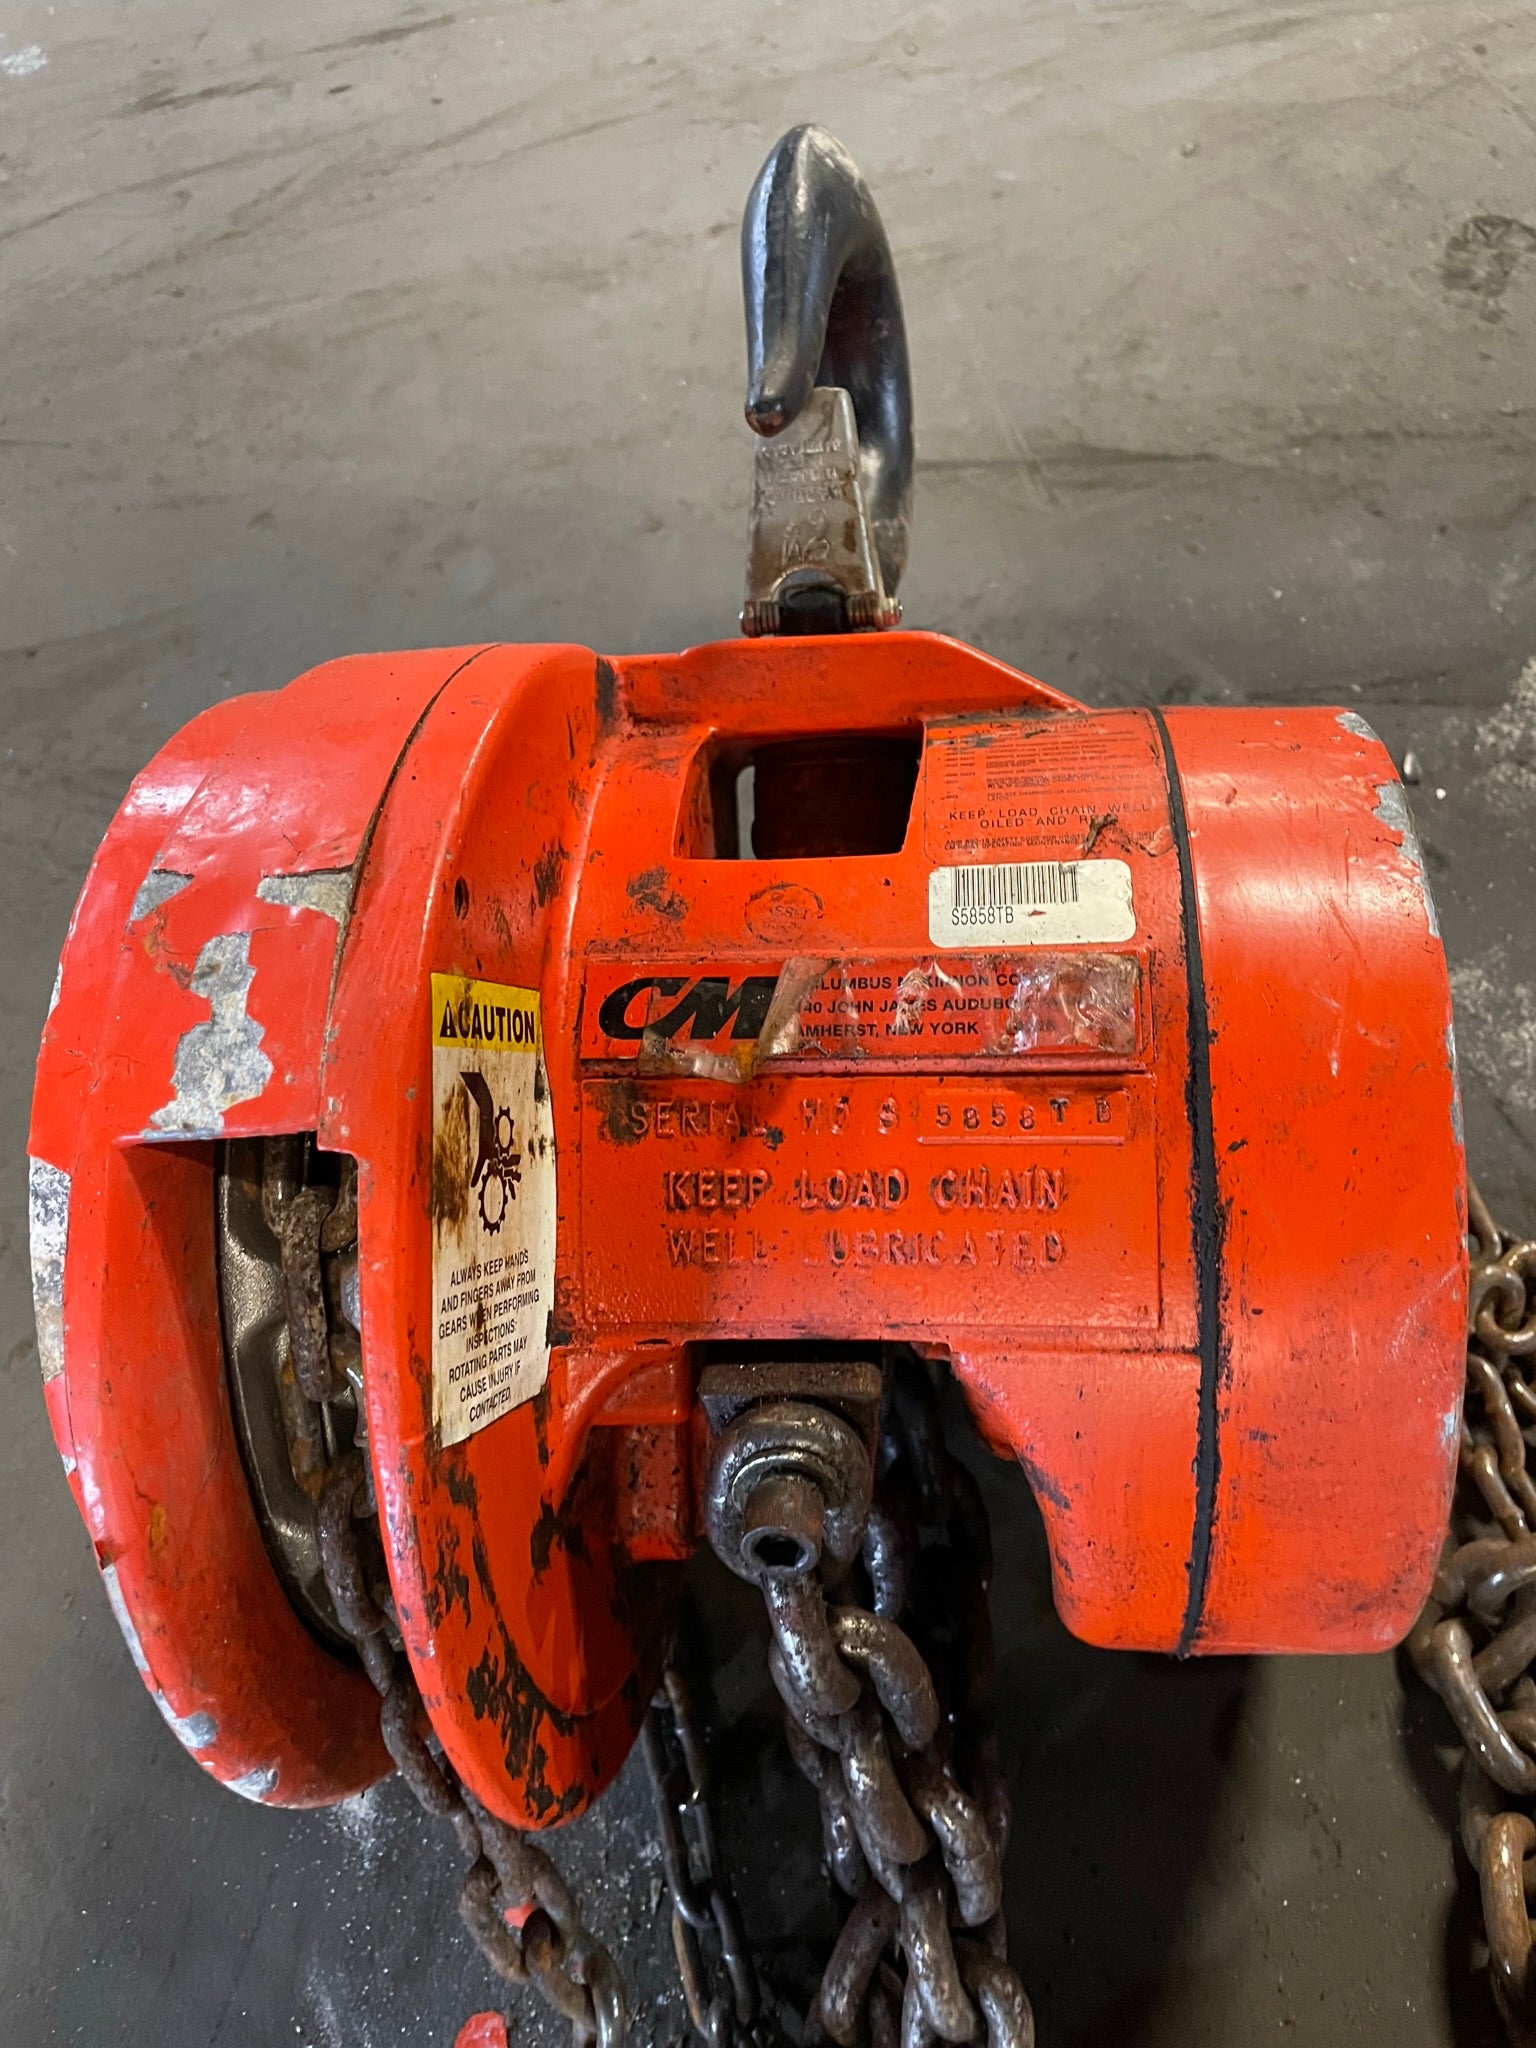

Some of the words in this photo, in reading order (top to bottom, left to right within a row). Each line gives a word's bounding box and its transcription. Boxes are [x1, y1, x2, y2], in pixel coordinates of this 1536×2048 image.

[949, 808, 986, 821] KEEP
[1000, 806, 1038, 818] LOAD
[1050, 804, 1096, 816] CHAIN
[980, 818, 1024, 830] OILED
[1036, 815, 1067, 827] AND
[951, 906, 1014, 925] S5858TB
[820, 976, 891, 990] LUMBUS
[458, 999, 535, 1044] CAUTION
[598, 976, 780, 1040] CM
[803, 1001, 822, 1014] 40
[828, 1000, 873, 1014] JOHN
[880, 998, 938, 1013] JAES
[930, 1021, 979, 1034] YORK
[630, 1098, 768, 1139] SERIAL
[665, 1167, 773, 1212] KEEP
[799, 1167, 909, 1211] LOAD
[931, 1166, 1067, 1210] CHAIN
[667, 1227, 773, 1267] WELL
[450, 1264, 482, 1288] ALWAYS
[483, 1258, 503, 1277] KEEP
[504, 1249, 529, 1270] HANDS
[441, 1294, 459, 1315] AND
[460, 1282, 494, 1308] FINGERS
[495, 1276, 515, 1296] AWAY
[517, 1268, 536, 1288] FROM
[439, 1314, 468, 1340] GEARS
[469, 1304, 492, 1329] WEN
[493, 1288, 540, 1319] PERFORMING
[448, 1353, 487, 1385] ROTATING
[488, 1341, 512, 1367] PARTS
[513, 1335, 528, 1354] MAY
[459, 1376, 487, 1403] CAUSE
[488, 1362, 514, 1390] INJURY
[514, 1359, 521, 1376] IF
